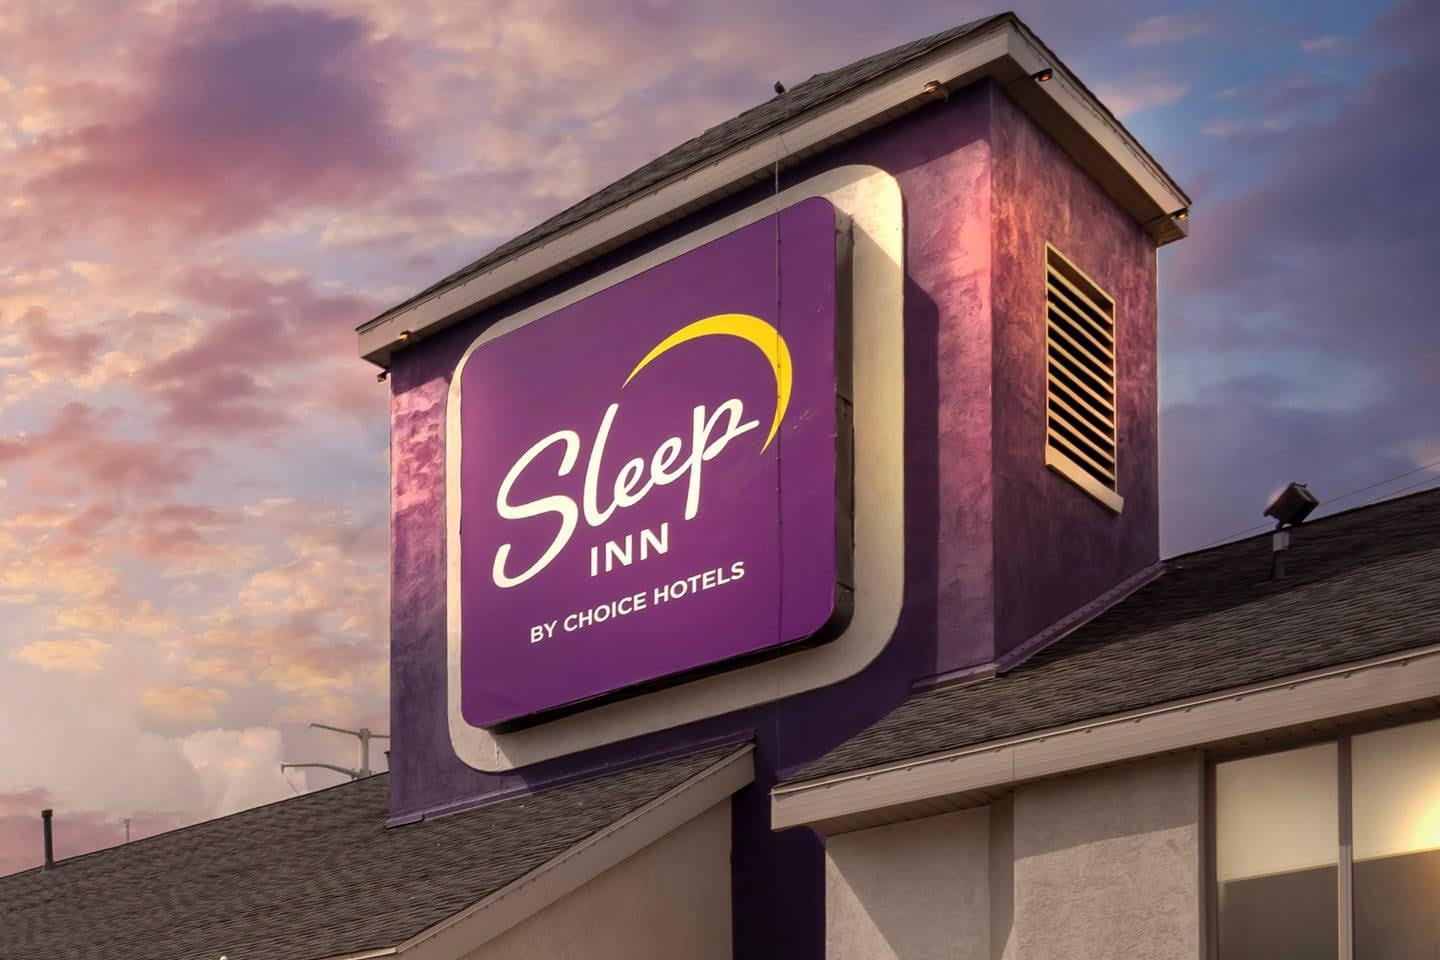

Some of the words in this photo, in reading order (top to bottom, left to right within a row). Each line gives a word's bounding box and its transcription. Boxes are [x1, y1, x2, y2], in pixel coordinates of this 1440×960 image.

[492, 398, 759, 588] Sleep
[590, 522, 669, 577] INN
[530, 619, 558, 644] BY
[563, 591, 647, 633] CHOICE
[654, 561, 745, 606] HOTELS
